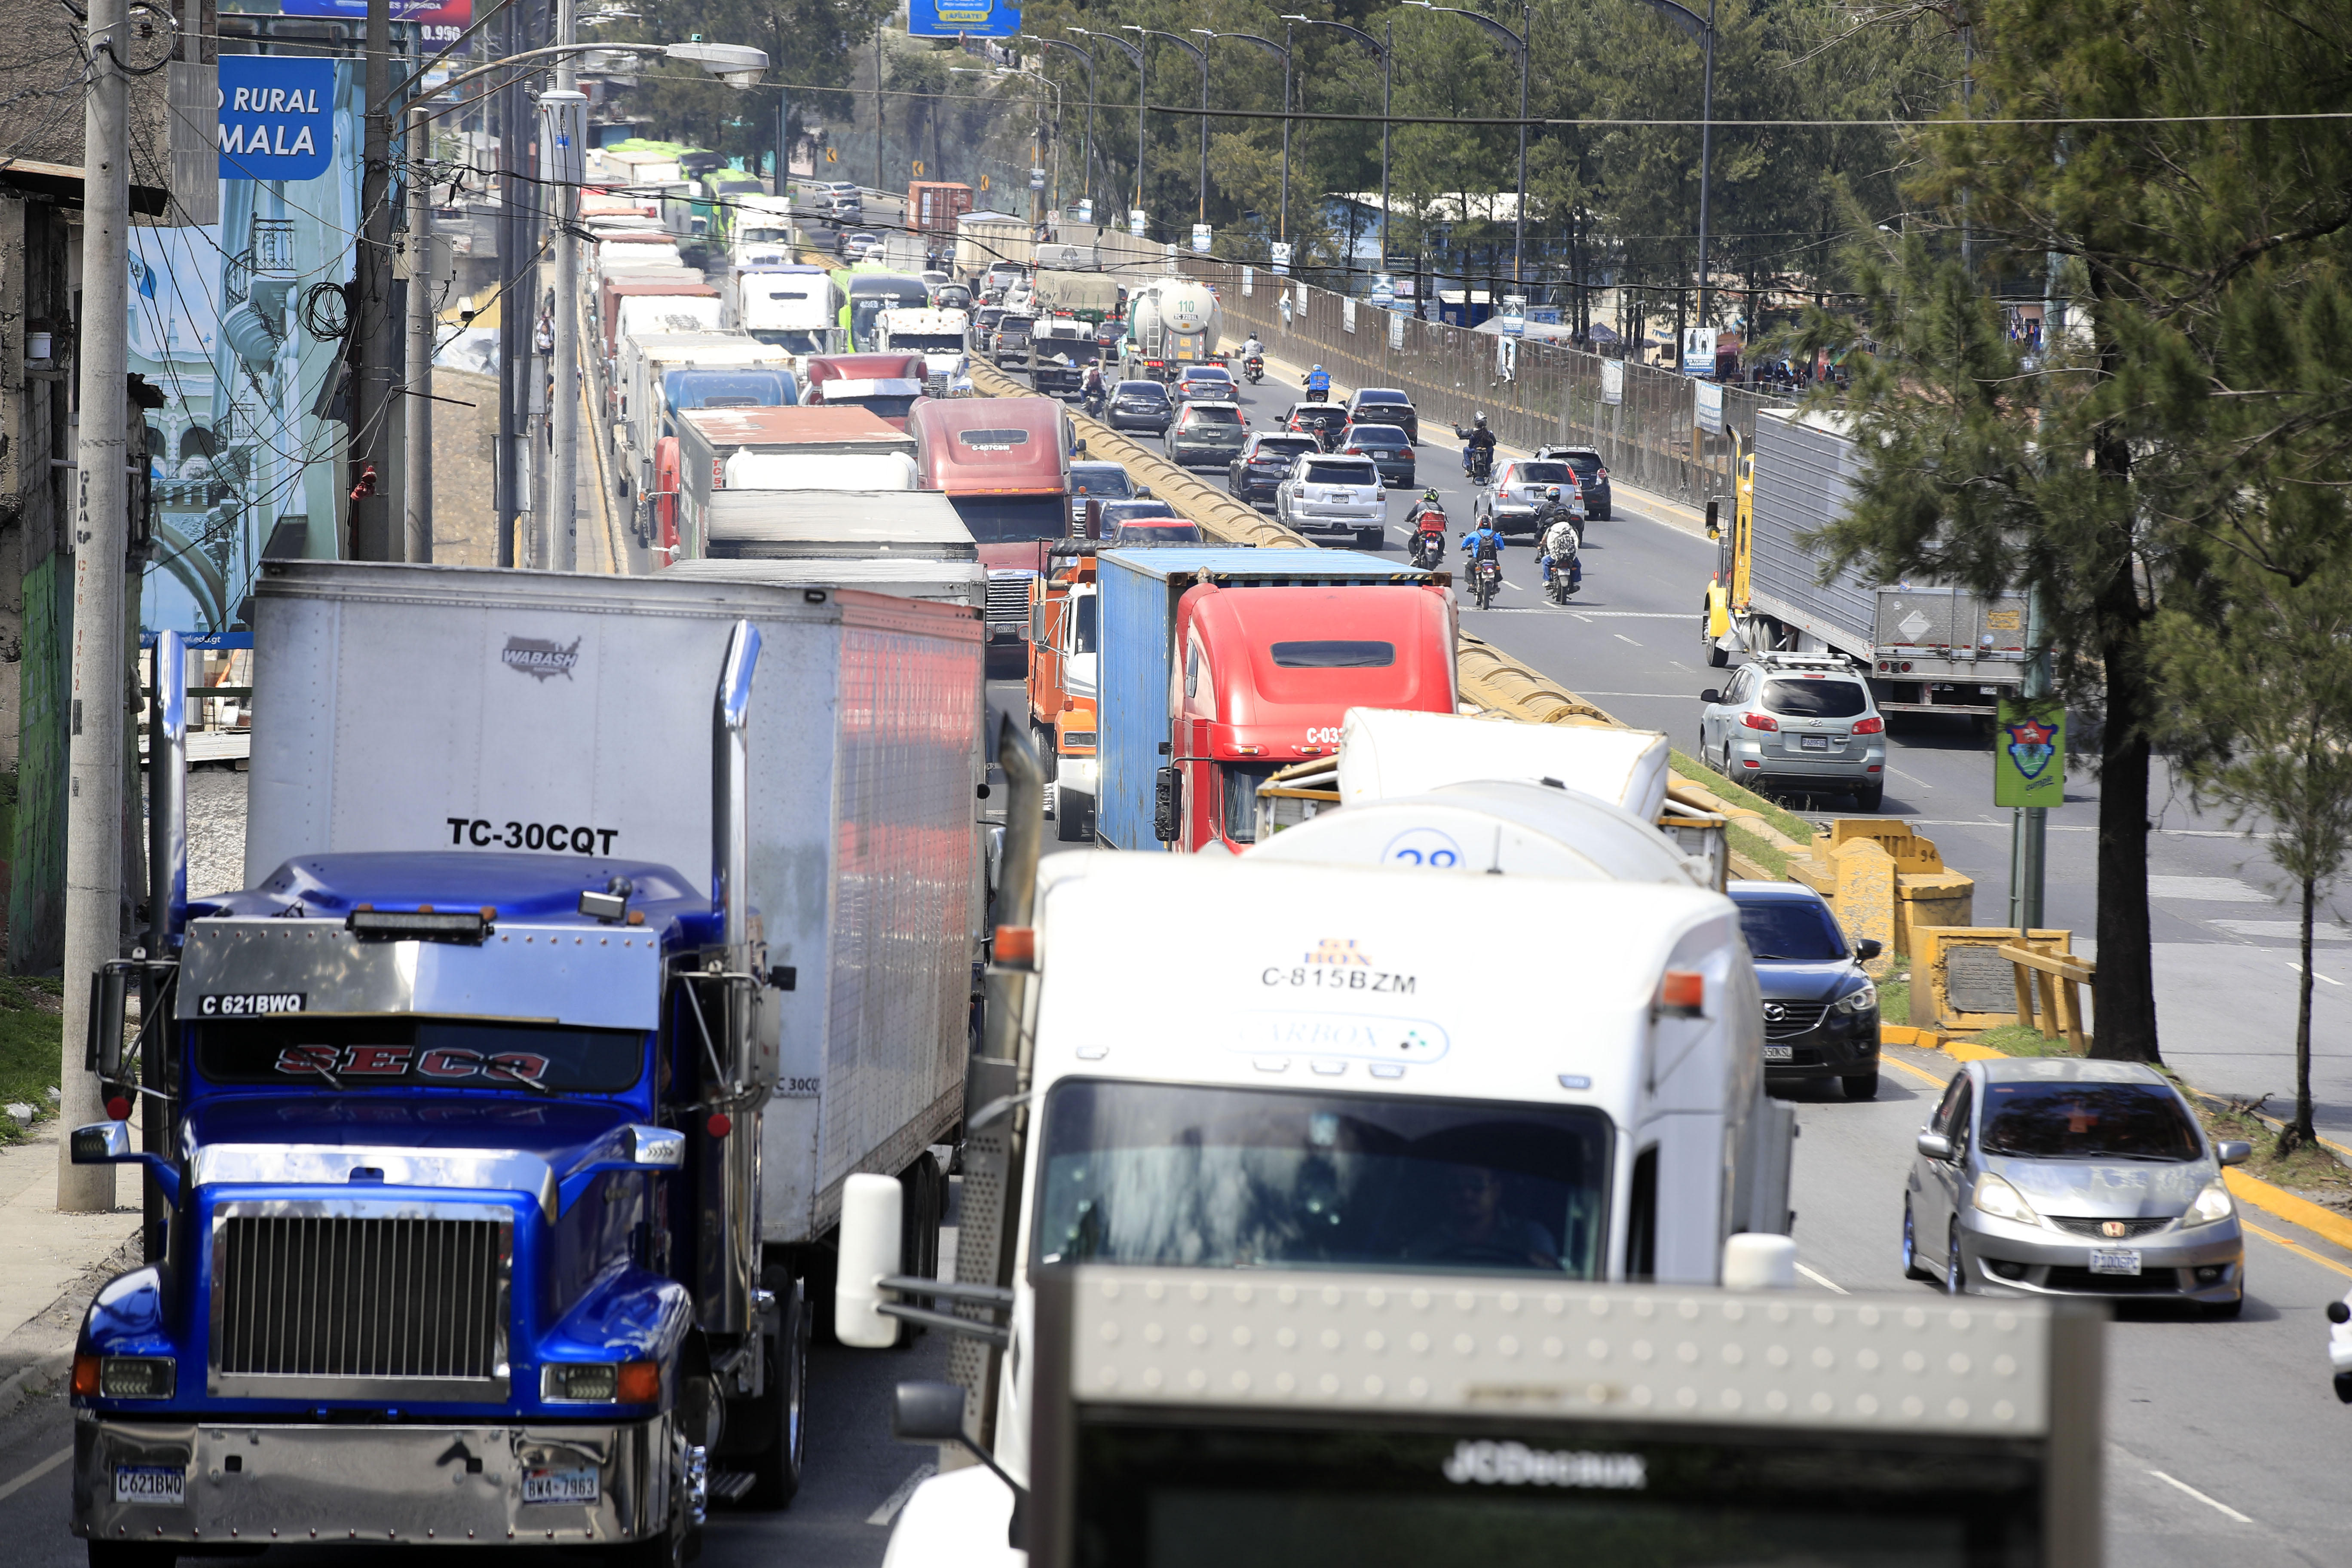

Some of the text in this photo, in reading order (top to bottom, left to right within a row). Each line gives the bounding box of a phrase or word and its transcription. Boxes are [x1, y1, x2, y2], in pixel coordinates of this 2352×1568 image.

[234, 87, 319, 113] RURAL
[218, 123, 315, 155] MALA
[1178, 300, 1194, 312] 110
[713, 460, 722, 488] TC5
[503, 650, 578, 667] WABASH
[447, 818, 618, 857] TC-30CQT
[1262, 967, 1416, 994] C-815BZM
[221, 994, 301, 1014] 621BWQ
[119, 1475, 181, 1494] C621BWQ
